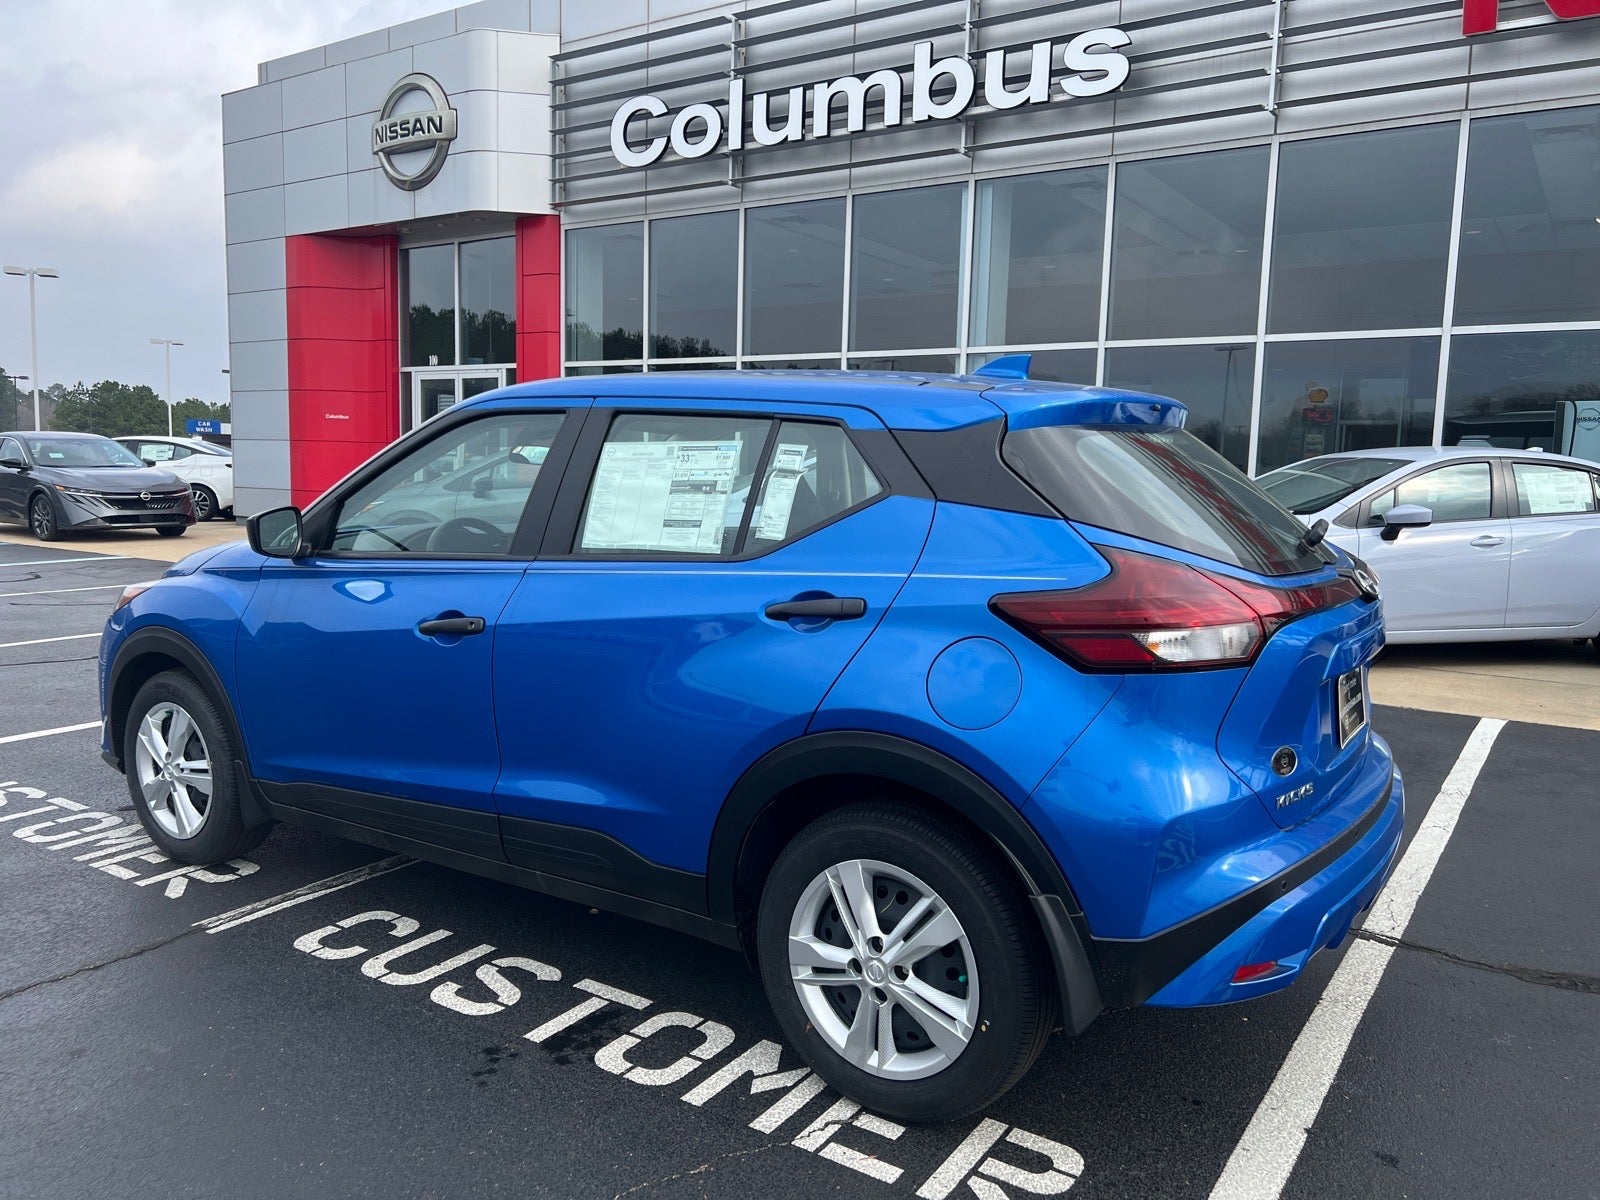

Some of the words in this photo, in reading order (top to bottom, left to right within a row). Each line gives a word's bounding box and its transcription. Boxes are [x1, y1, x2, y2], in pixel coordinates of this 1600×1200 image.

[375, 115, 443, 145] NISSAN
[610, 27, 1132, 168] Columbus
[428, 354, 438, 366] 100
[293, 909, 1085, 1200] CUSTOMER
